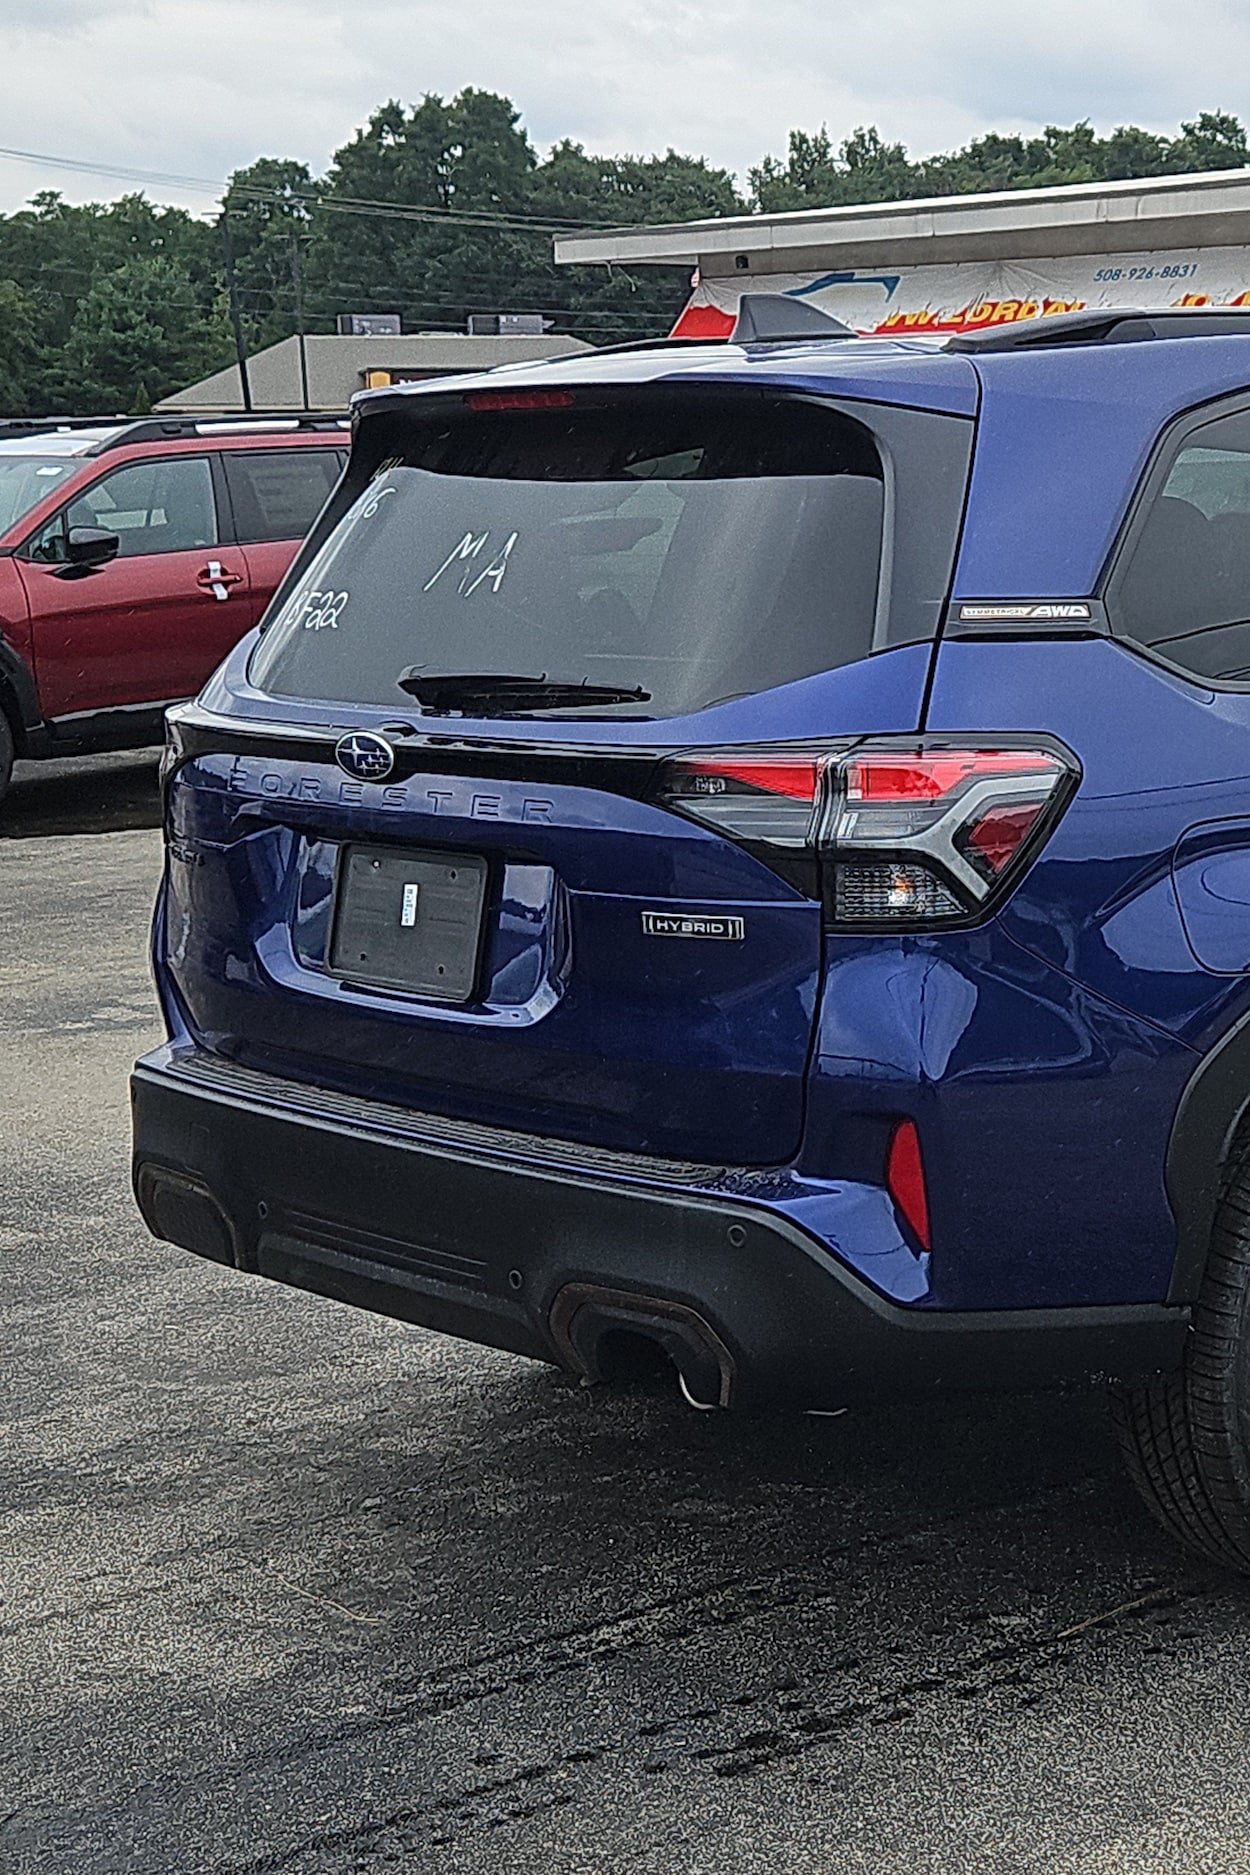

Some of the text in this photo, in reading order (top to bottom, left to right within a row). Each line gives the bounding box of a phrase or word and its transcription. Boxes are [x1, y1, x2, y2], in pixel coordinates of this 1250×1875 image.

[1093, 264, 1199, 282] 508-926-8831
[423, 531, 520, 598] MA
[230, 764, 556, 823] FORESTER
[656, 919, 724, 933] HYBRID
